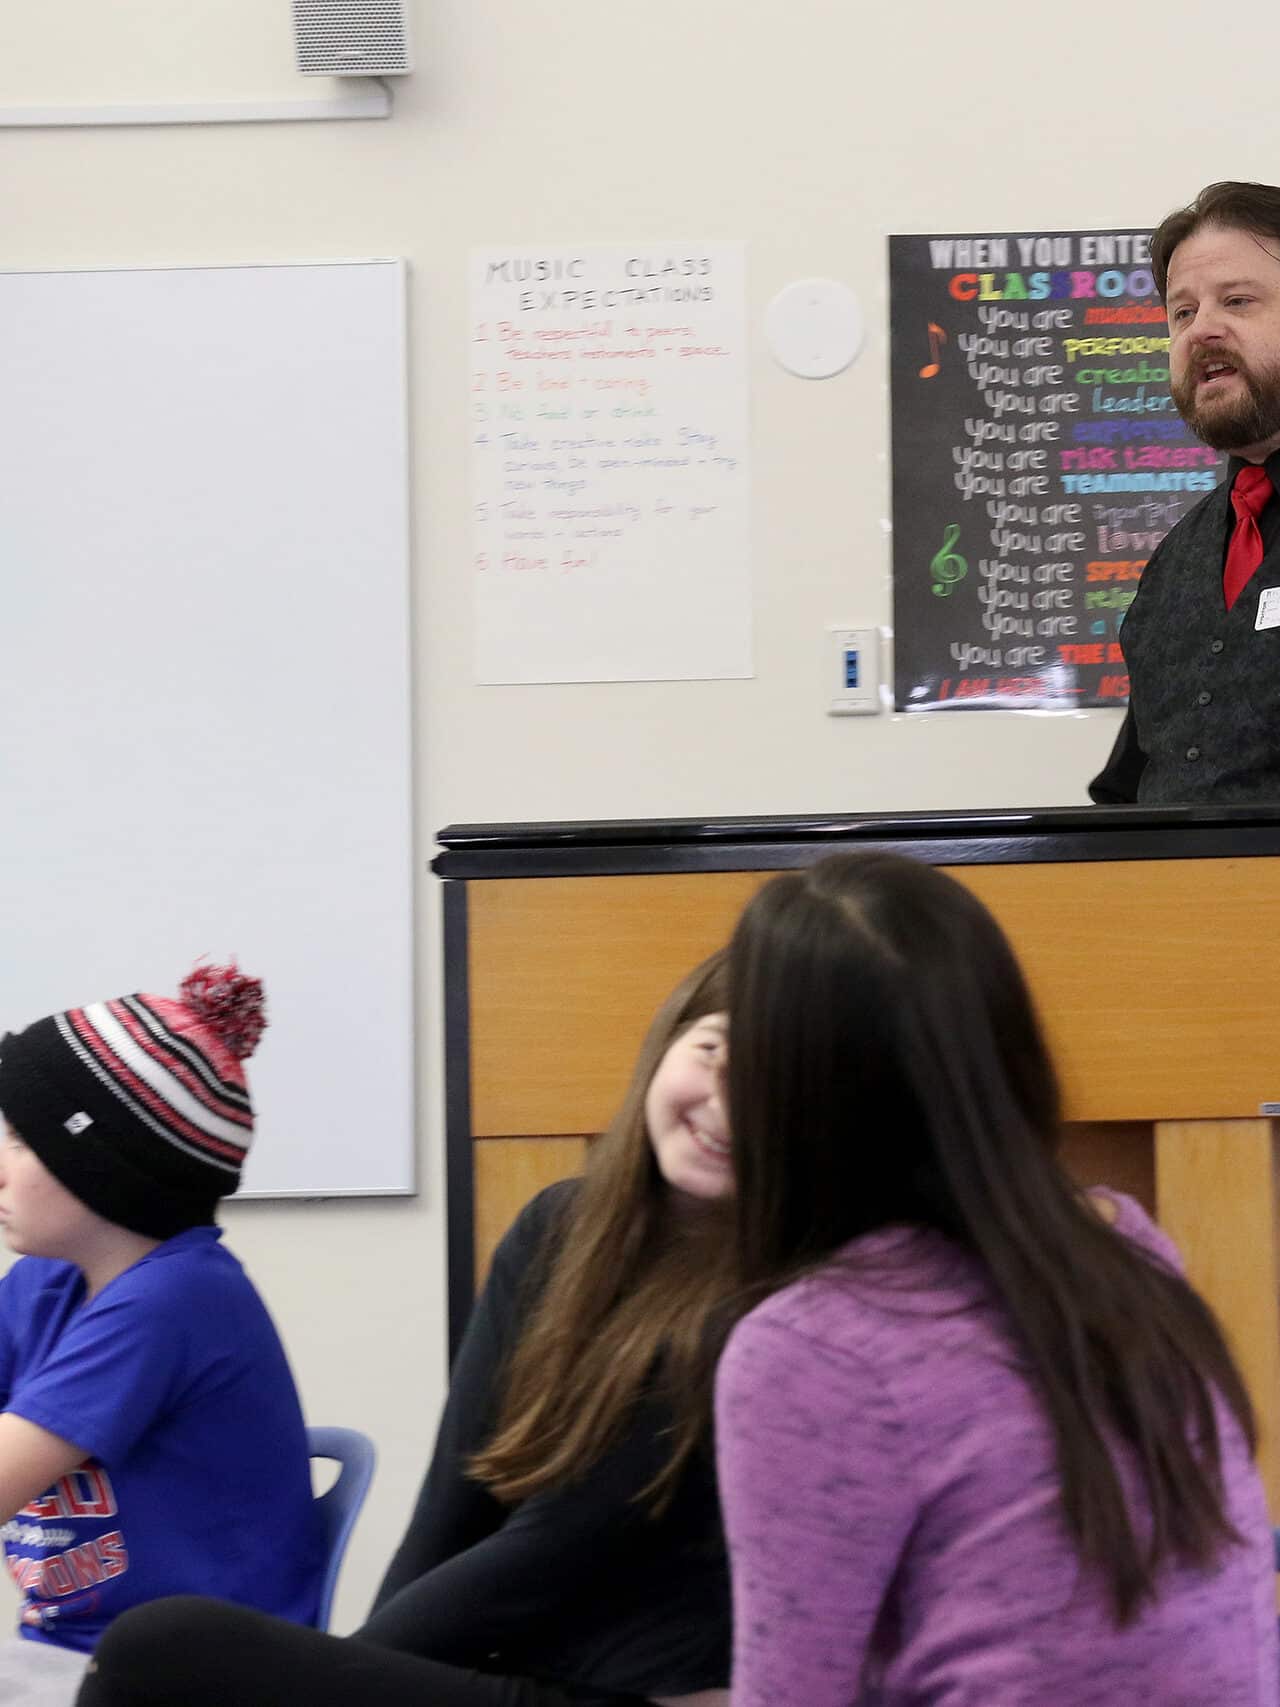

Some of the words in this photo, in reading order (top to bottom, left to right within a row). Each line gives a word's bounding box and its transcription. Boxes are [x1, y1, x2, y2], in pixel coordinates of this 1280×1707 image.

[929, 239, 1008, 269] WHEN
[1017, 237, 1071, 267] YOU
[1080, 235, 1153, 266] ENTE
[484, 258, 585, 285] MUSIC
[624, 257, 713, 279] CLASS
[949, 270, 1159, 300] CLASSROO
[520, 286, 713, 311] EXPECTATIONS
[1032, 308, 1073, 331] are
[1012, 336, 1053, 358] are
[1023, 365, 1064, 387] are
[1075, 360, 1170, 384] creato
[1039, 392, 1080, 414] are
[1019, 421, 1061, 443] are
[1007, 450, 1048, 471] are
[1008, 475, 1049, 496] are
[1041, 503, 1082, 525] are
[1044, 531, 1086, 553] are
[1097, 525, 1167, 553] love
[1033, 562, 1074, 583] are
[1087, 559, 1149, 582] SPEC
[1033, 588, 1073, 611] are
[1037, 615, 1078, 637] are
[1004, 645, 1046, 667] are
